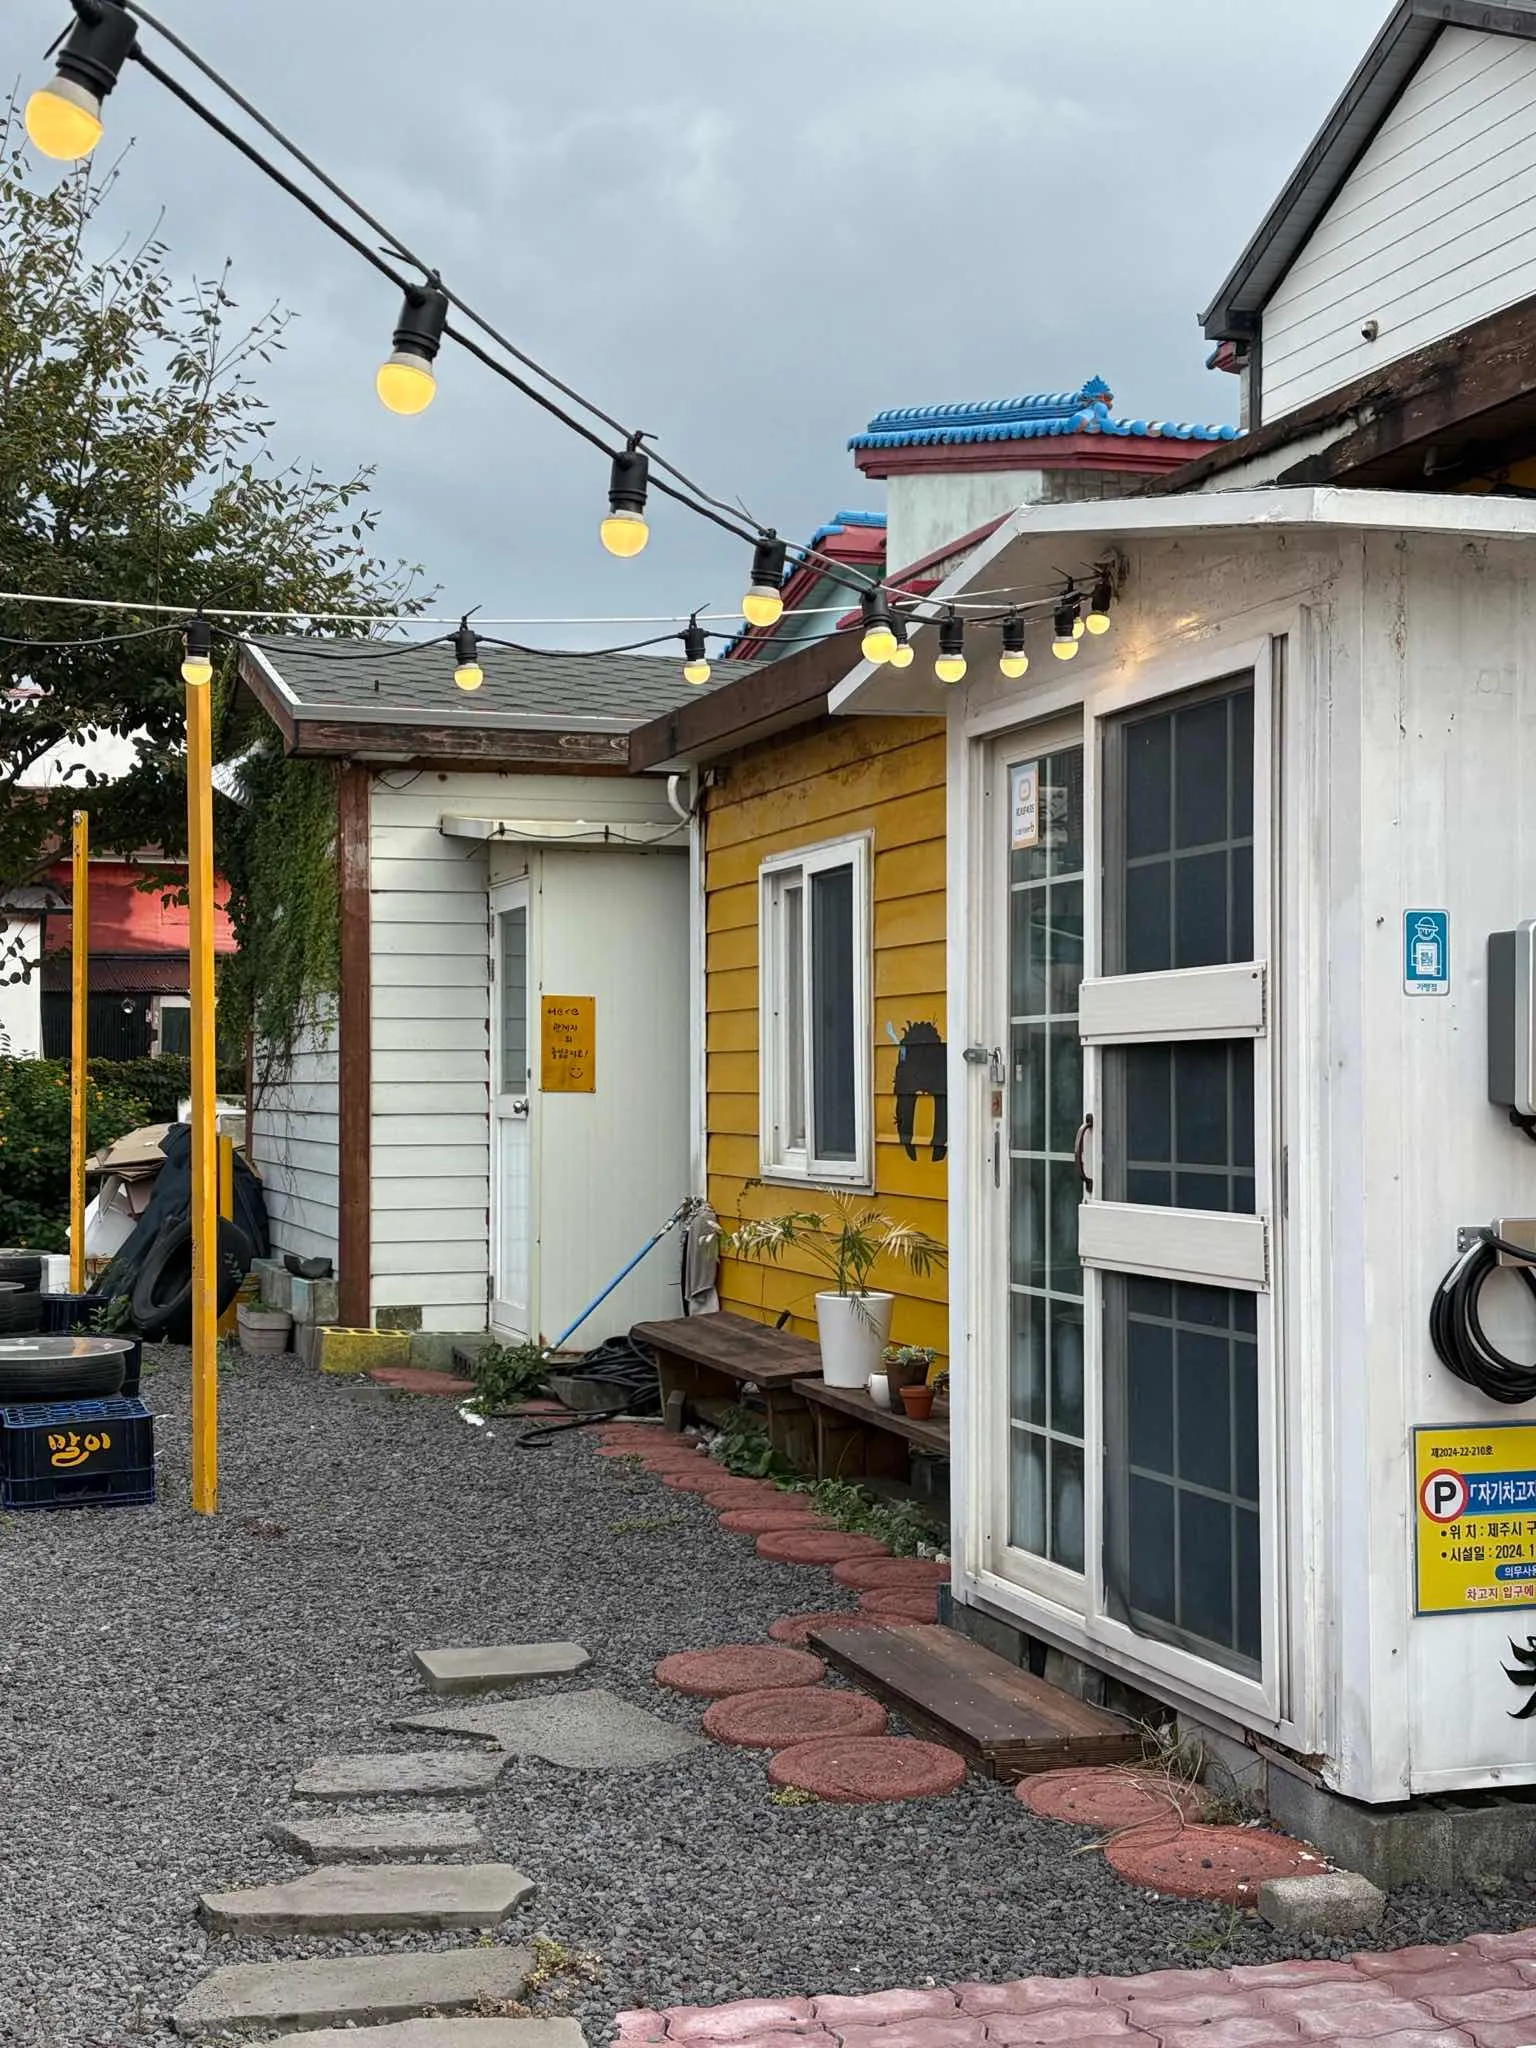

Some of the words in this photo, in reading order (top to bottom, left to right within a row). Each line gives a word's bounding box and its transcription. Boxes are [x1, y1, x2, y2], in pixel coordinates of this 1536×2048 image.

[1430, 1445, 1494, 1458] 제2024-22-210호
[1434, 1481, 1457, 1514] P
[1487, 1521, 1522, 1537] 제주시
[1450, 1545, 1485, 1562] 시설일
[1495, 1543, 1525, 1559] 2024.
[1467, 1587, 1498, 1601] 차고지
[1503, 1584, 1534, 1599] 입구에
